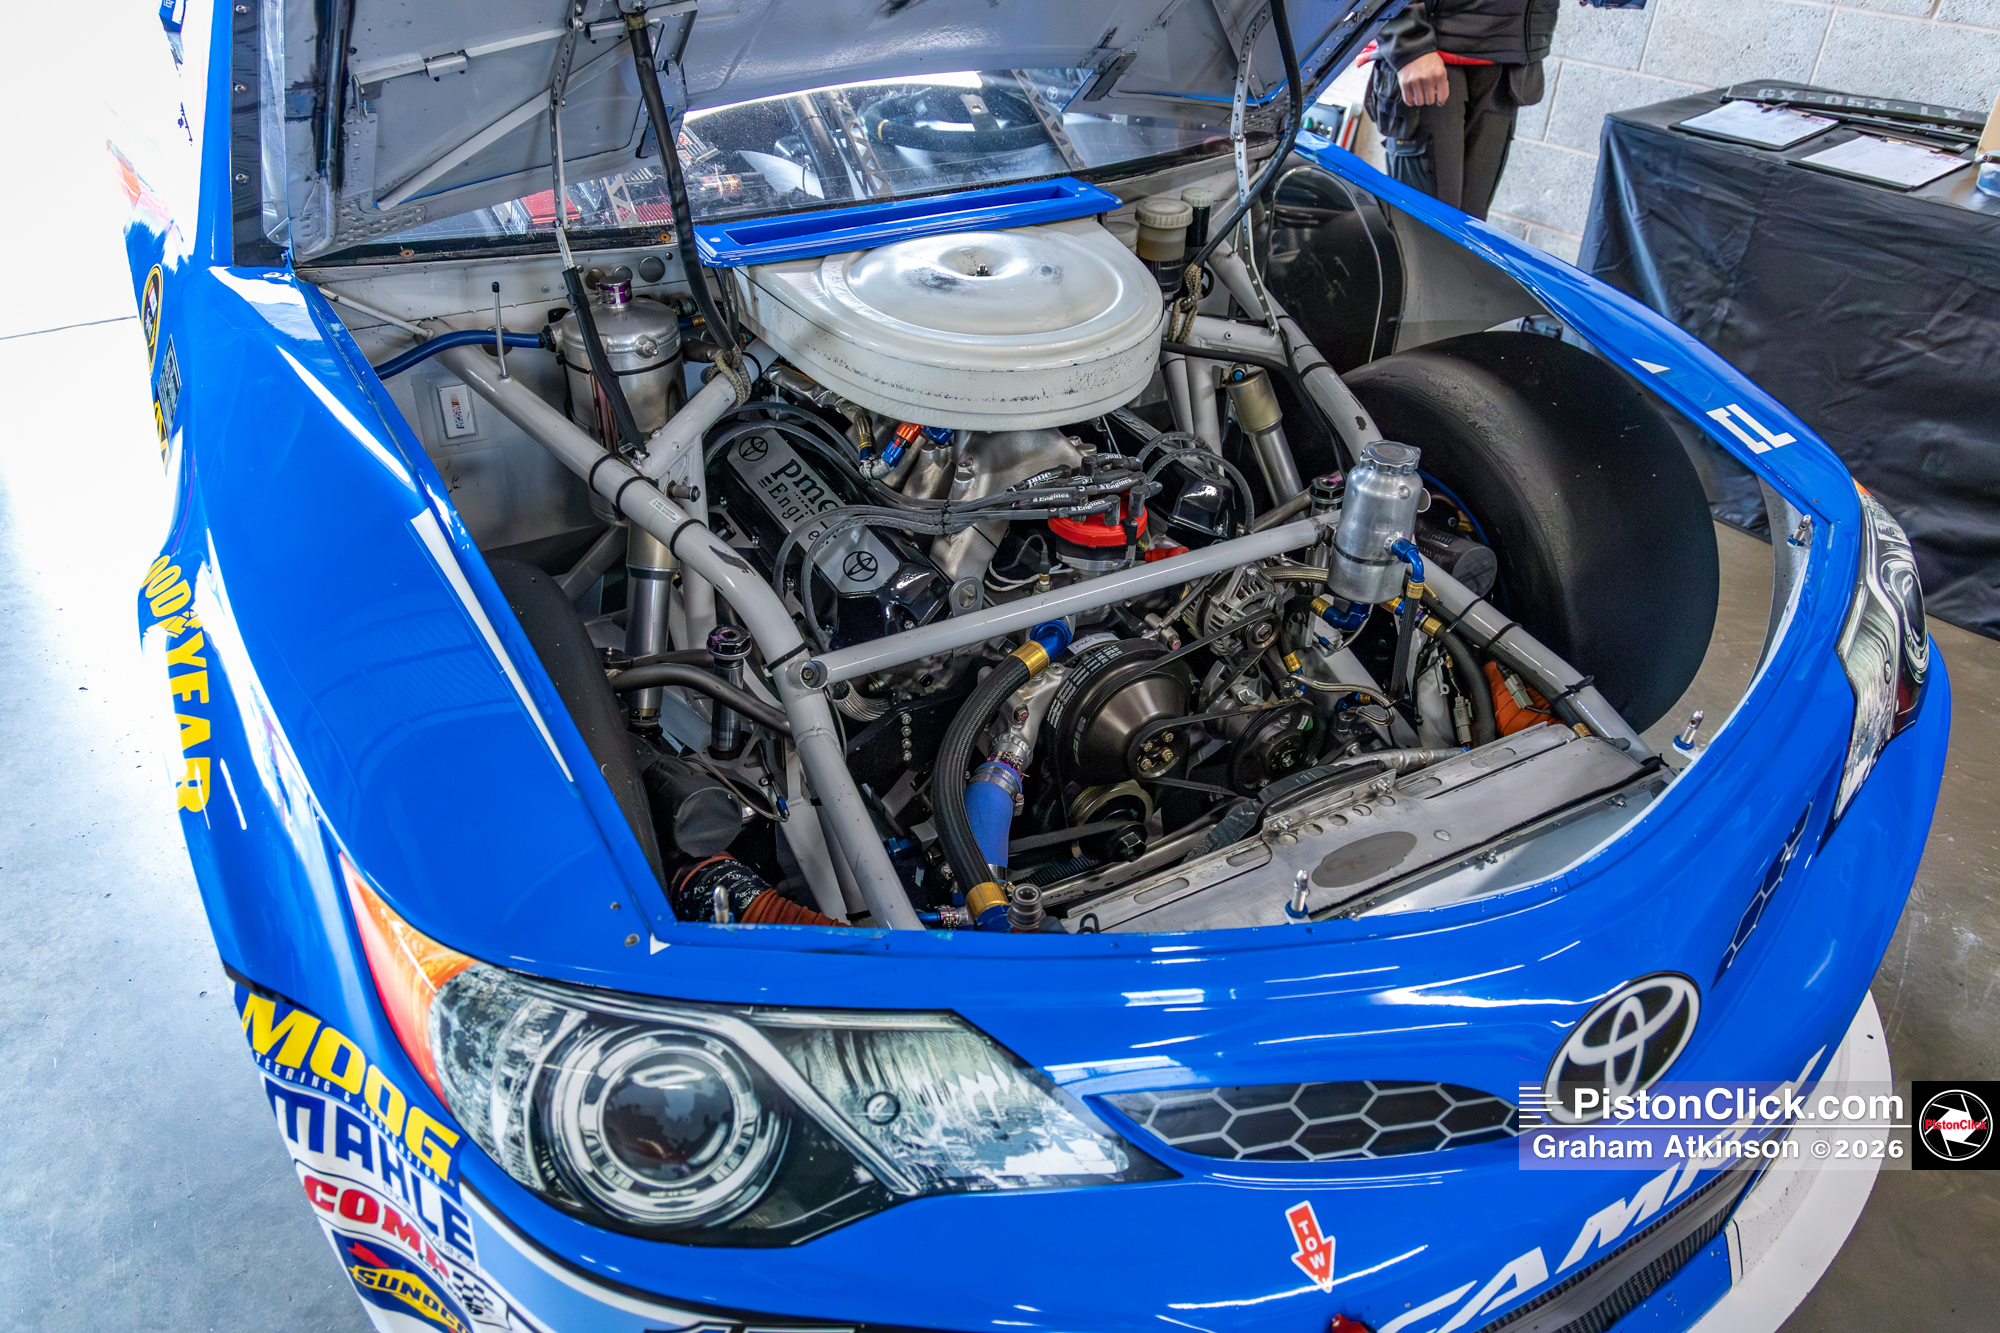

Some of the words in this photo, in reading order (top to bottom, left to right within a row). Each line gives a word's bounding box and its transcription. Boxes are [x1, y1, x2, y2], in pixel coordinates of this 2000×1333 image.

[1038, 492, 1070, 503] Engines
[140, 554, 211, 813] OODYEAR
[242, 992, 460, 1182] MOOG
[255, 1051, 332, 1092] TEERING
[361, 1102, 442, 1186] SUSPENSION
[264, 1076, 476, 1264] MAHLE
[304, 1175, 450, 1279] COMP
[1297, 1219, 1326, 1270] TOW
